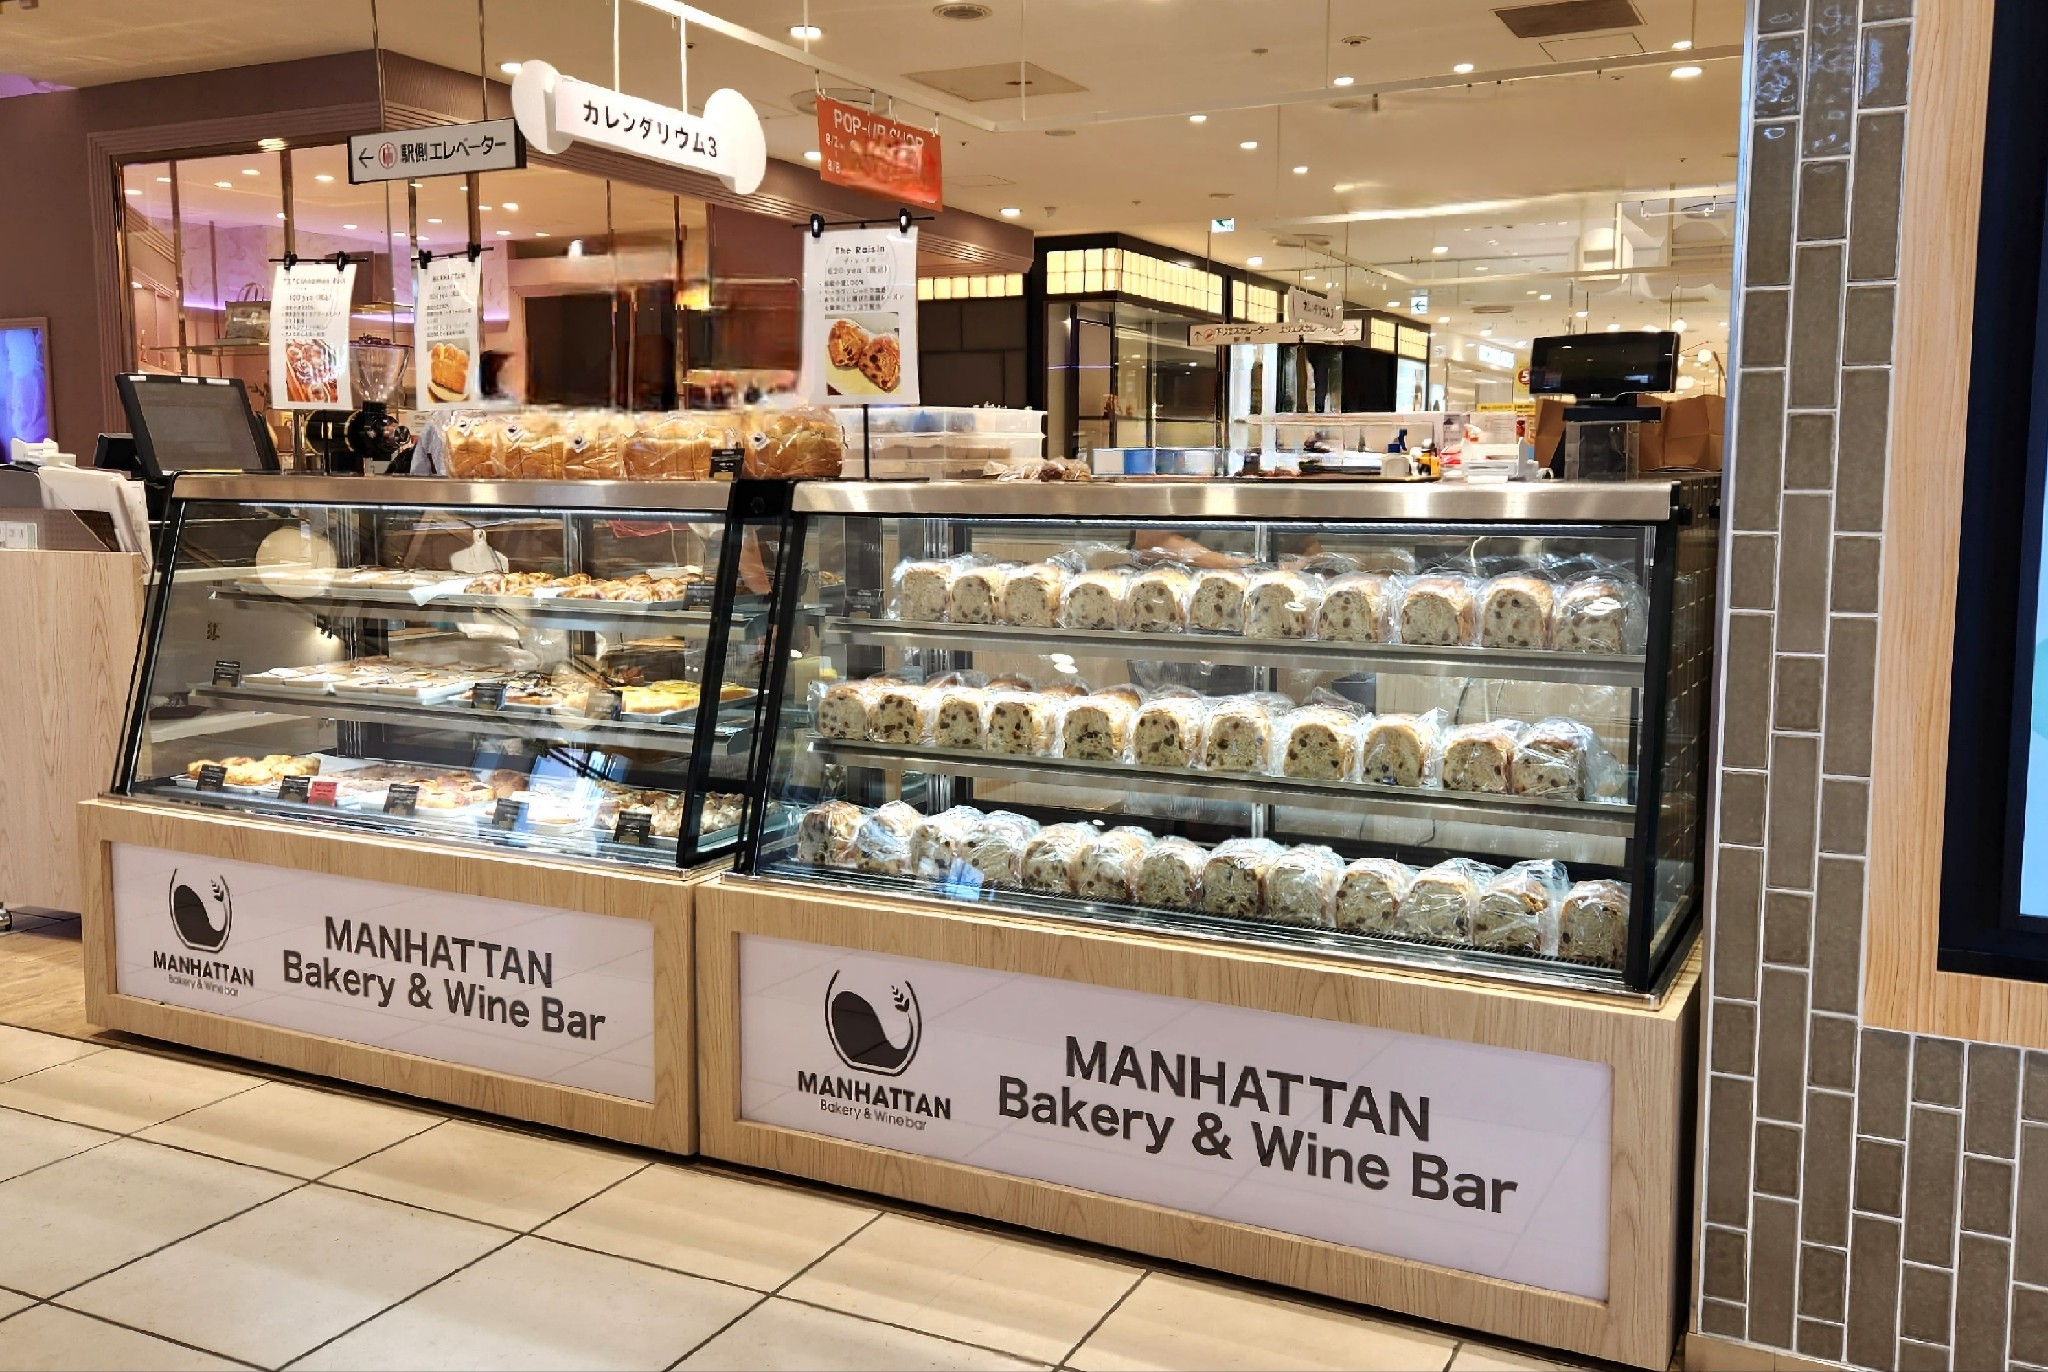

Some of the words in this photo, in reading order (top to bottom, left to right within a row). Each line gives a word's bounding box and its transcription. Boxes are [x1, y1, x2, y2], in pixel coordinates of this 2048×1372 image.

[401, 135, 506, 163] 駅側エレベーター
[583, 100, 717, 157] カレンダリウム3
[835, 246, 852, 254] The
[855, 245, 885, 254] Raisin
[153, 951, 254, 987] MANHATTAN
[325, 916, 552, 988] MANHATTAN
[283, 950, 396, 1008] Bakery
[408, 972, 433, 1010] &
[444, 978, 530, 1028] Wine
[541, 996, 606, 1041] Bar
[798, 1070, 951, 1120] MANHATTAN
[820, 1098, 861, 1121] Bakery
[863, 1107, 872, 1120] &
[1065, 1035, 1430, 1142] MANHATTAN
[999, 1074, 1175, 1155] Bakery
[1191, 1111, 1233, 1160] &
[1250, 1120, 1390, 1191] Wine
[1412, 1151, 1519, 1214] Bar
